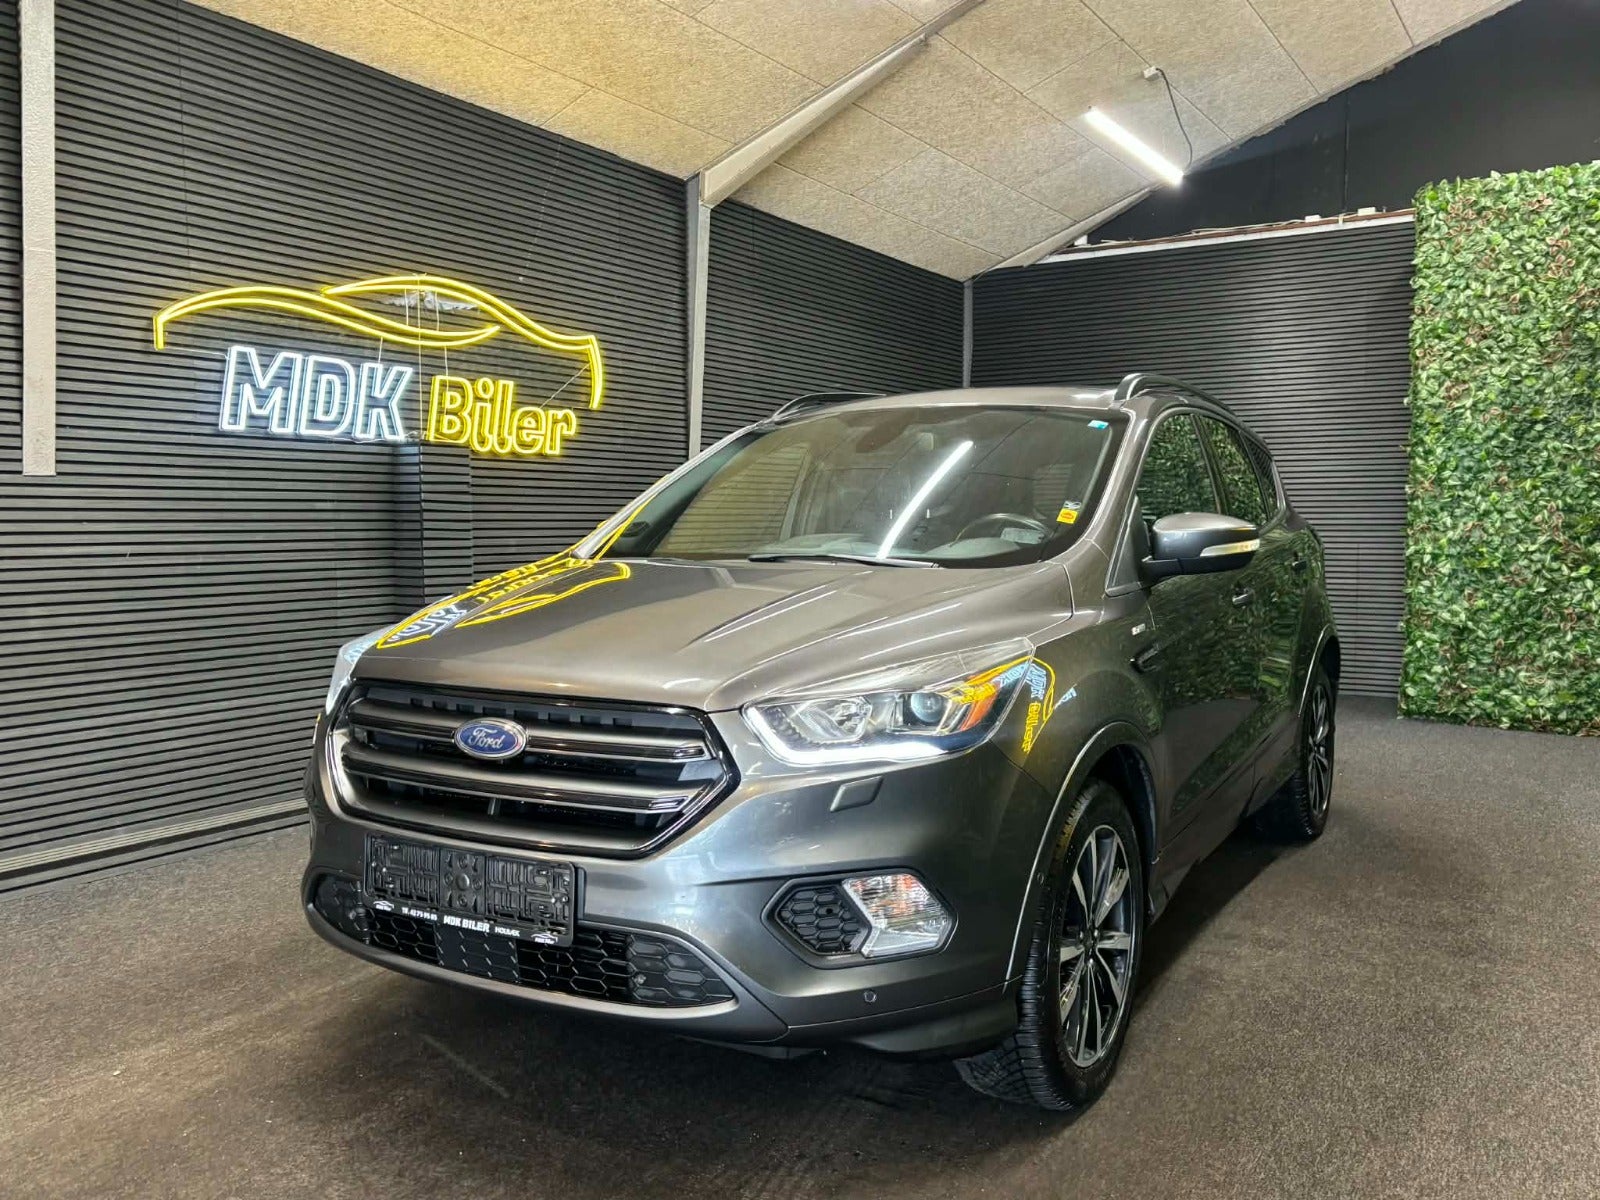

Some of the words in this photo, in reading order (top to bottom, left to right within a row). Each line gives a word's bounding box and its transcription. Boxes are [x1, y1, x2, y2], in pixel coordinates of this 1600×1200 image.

[219, 345, 413, 441] MDK
[425, 374, 577, 456] Biler
[468, 727, 506, 749] Ford
[443, 914, 461, 927] MDK
[462, 918, 491, 933] BILER
